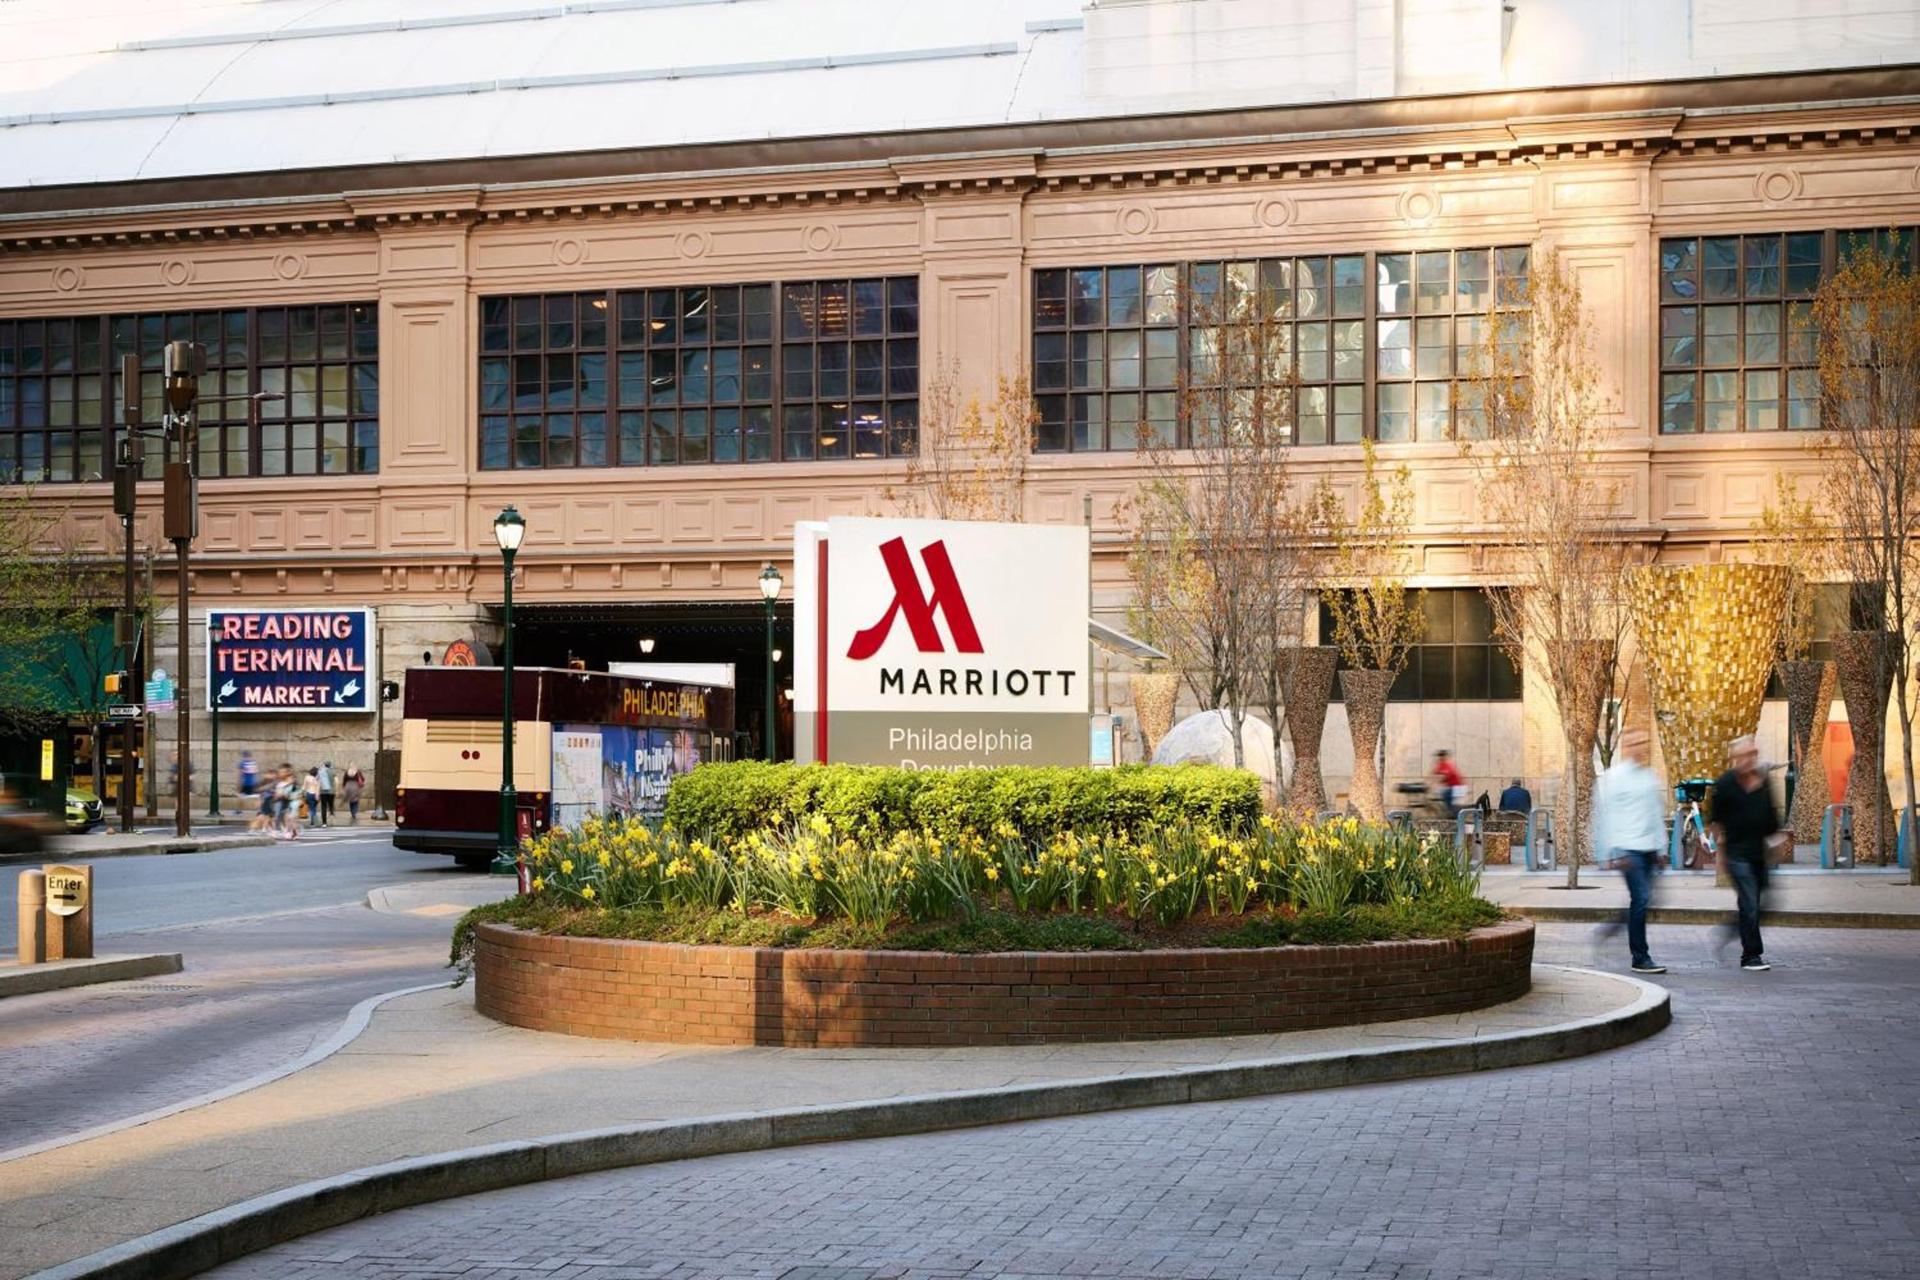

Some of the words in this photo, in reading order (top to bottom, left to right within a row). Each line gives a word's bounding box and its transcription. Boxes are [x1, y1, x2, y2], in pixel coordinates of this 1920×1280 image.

[222, 614, 353, 640] READING
[217, 647, 364, 672] TERMINAL
[244, 685, 331, 705] MARKET
[879, 667, 1077, 697] MARRIOTT
[623, 688, 706, 719] PHILADELPHIA
[888, 727, 1033, 756] Philadelphia
[48, 876, 83, 891] Enter
